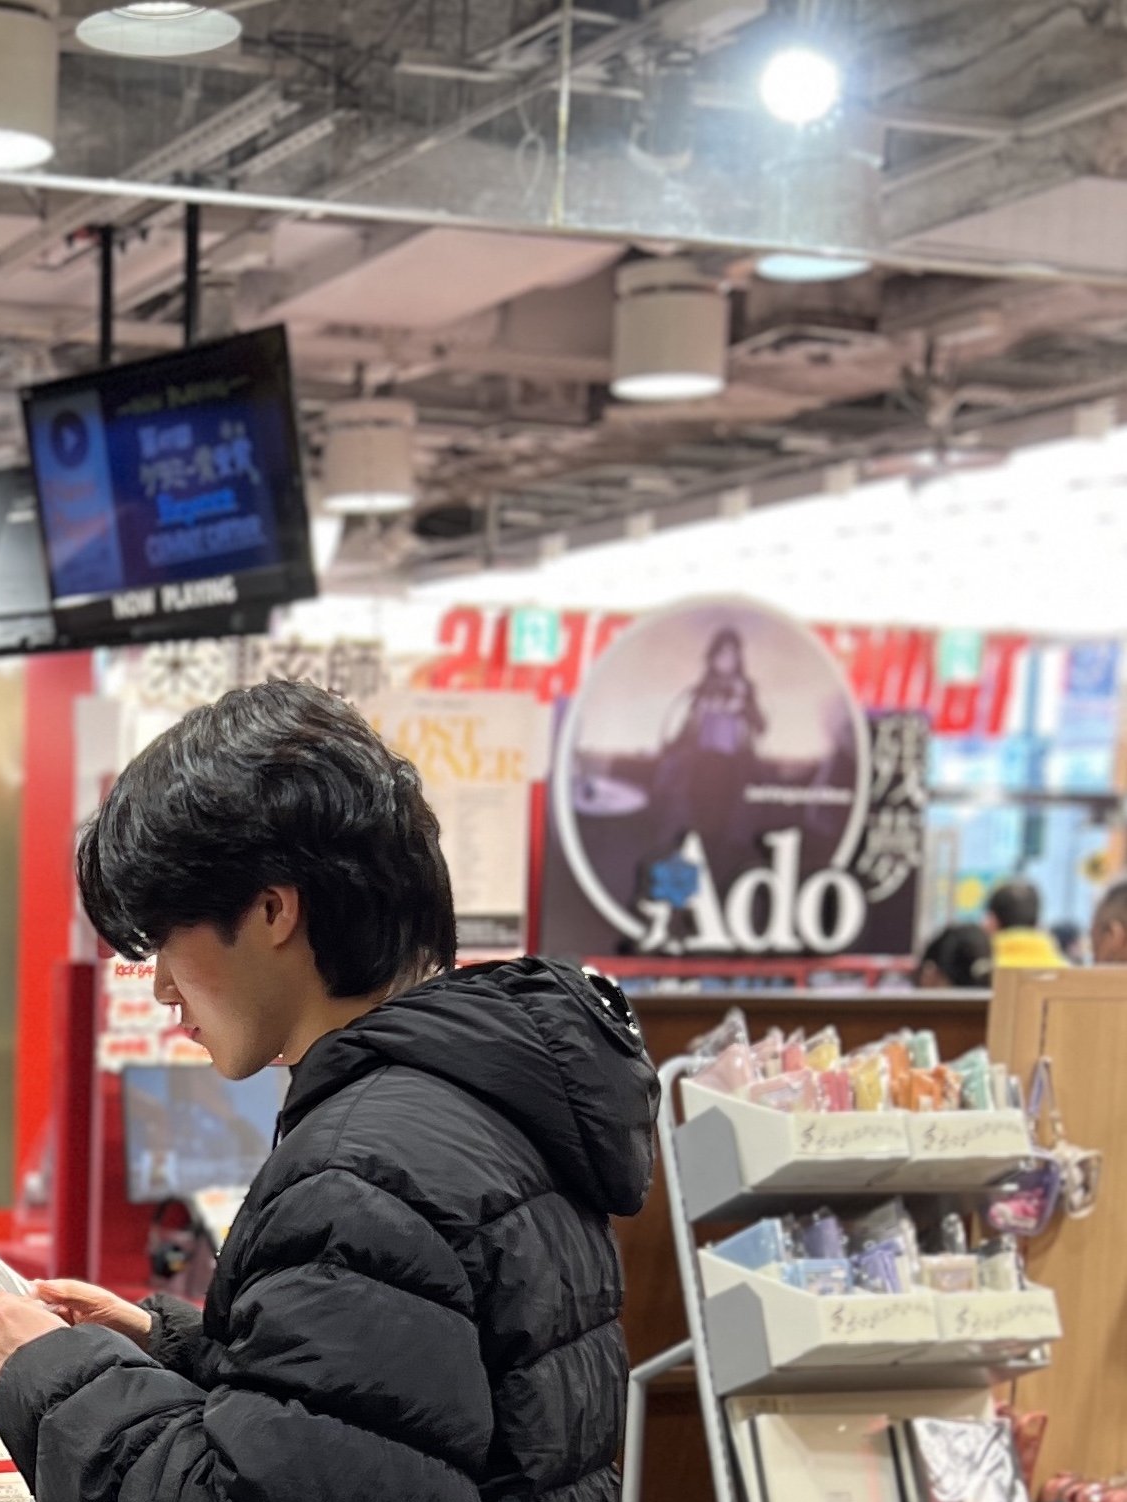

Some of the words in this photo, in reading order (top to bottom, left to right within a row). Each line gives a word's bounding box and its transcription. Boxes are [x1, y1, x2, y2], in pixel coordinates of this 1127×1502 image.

[112, 586, 157, 620] NOW
[161, 575, 238, 613] PLAYING
[638, 827, 868, 955] Ado
